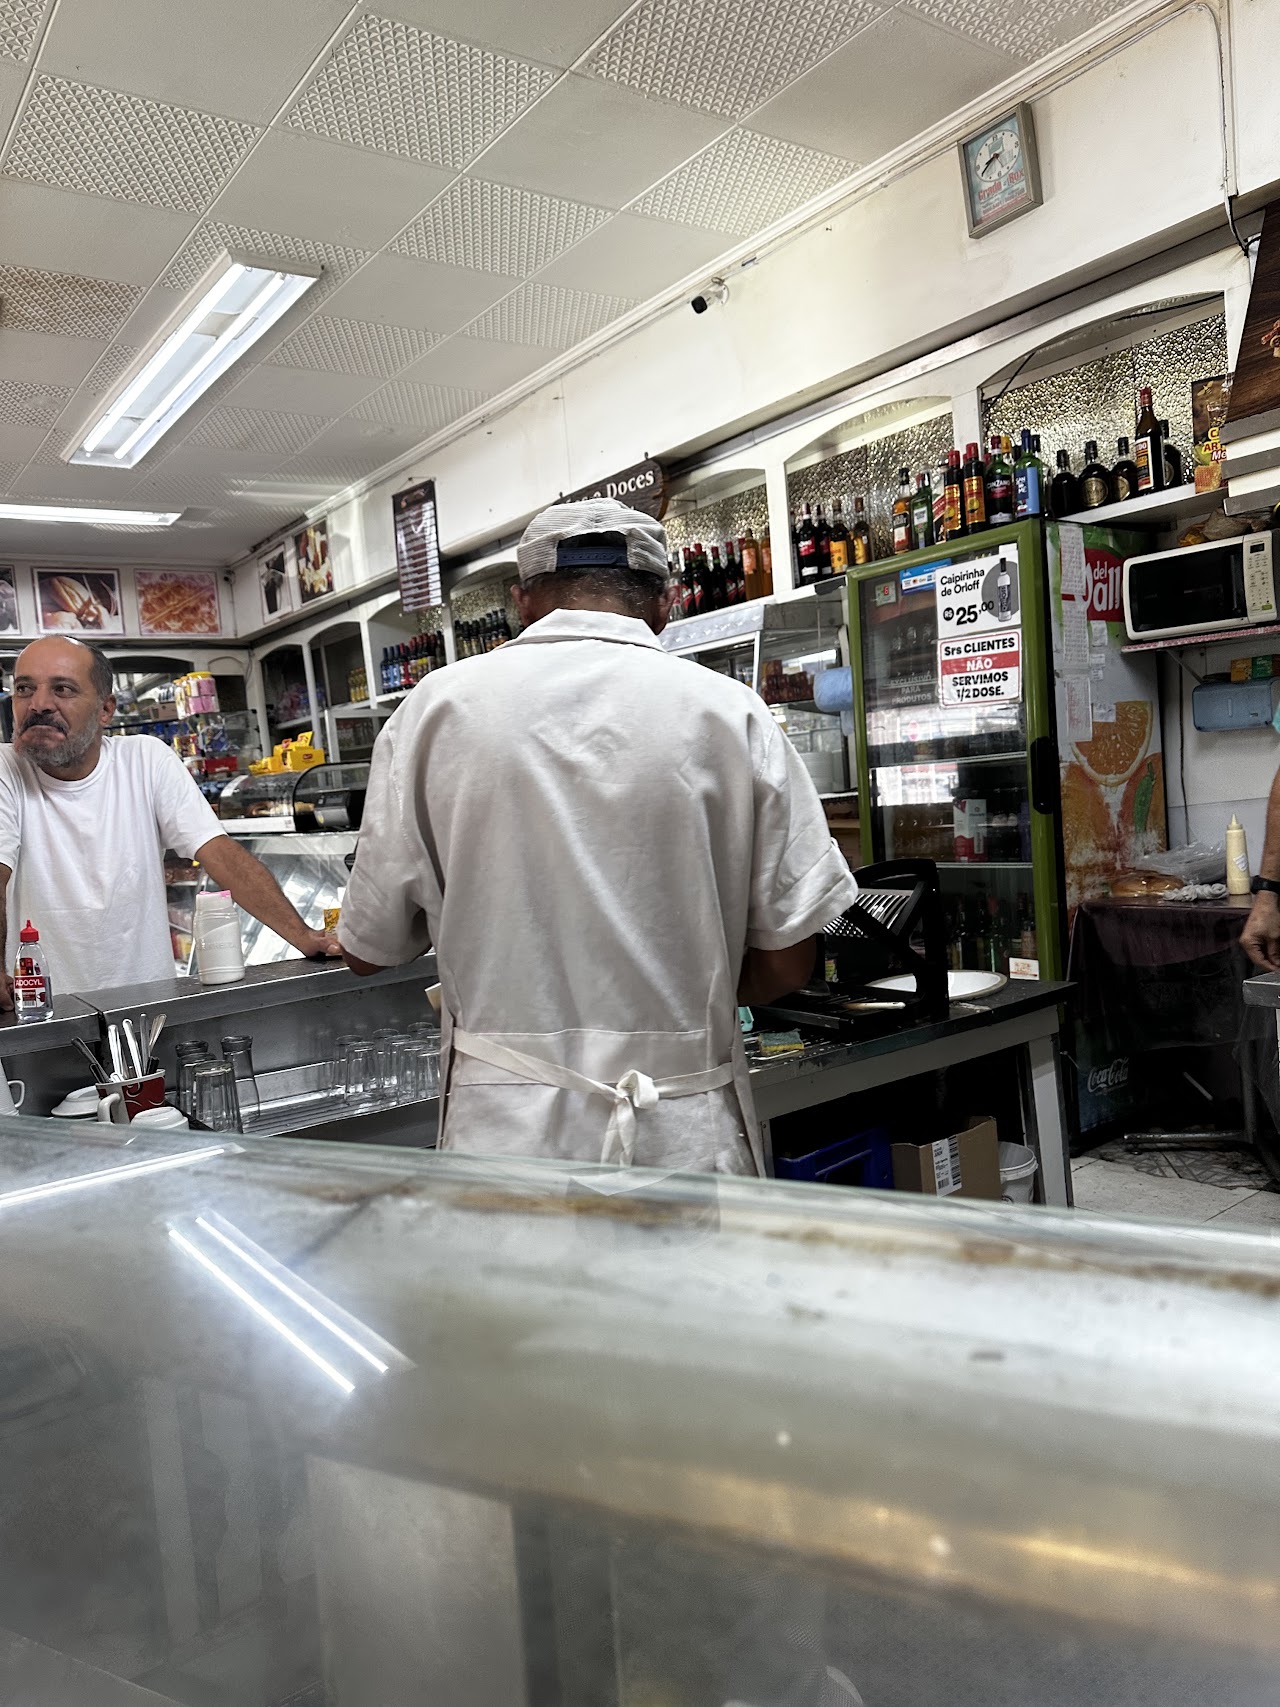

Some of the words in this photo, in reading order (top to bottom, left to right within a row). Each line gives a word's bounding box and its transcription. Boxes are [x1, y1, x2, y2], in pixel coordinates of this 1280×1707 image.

[606, 470, 655, 499] Doces
[940, 568, 985, 586] Caipirinha
[1093, 560, 1108, 580] del
[941, 587, 952, 597] de
[954, 579, 980, 594] Orloff
[944, 646, 962, 656] Srs
[964, 637, 1015, 653] CLIENTES
[966, 657, 993, 671] NÃO
[952, 671, 1008, 687] SERVIMOS
[901, 685, 921, 695] PARA
[956, 687, 971, 702] 1/2
[972, 686, 1004, 698] DOSE.
[891, 692, 932, 706] PRODUTOS
[15, 978, 43, 987] ADOCYL
